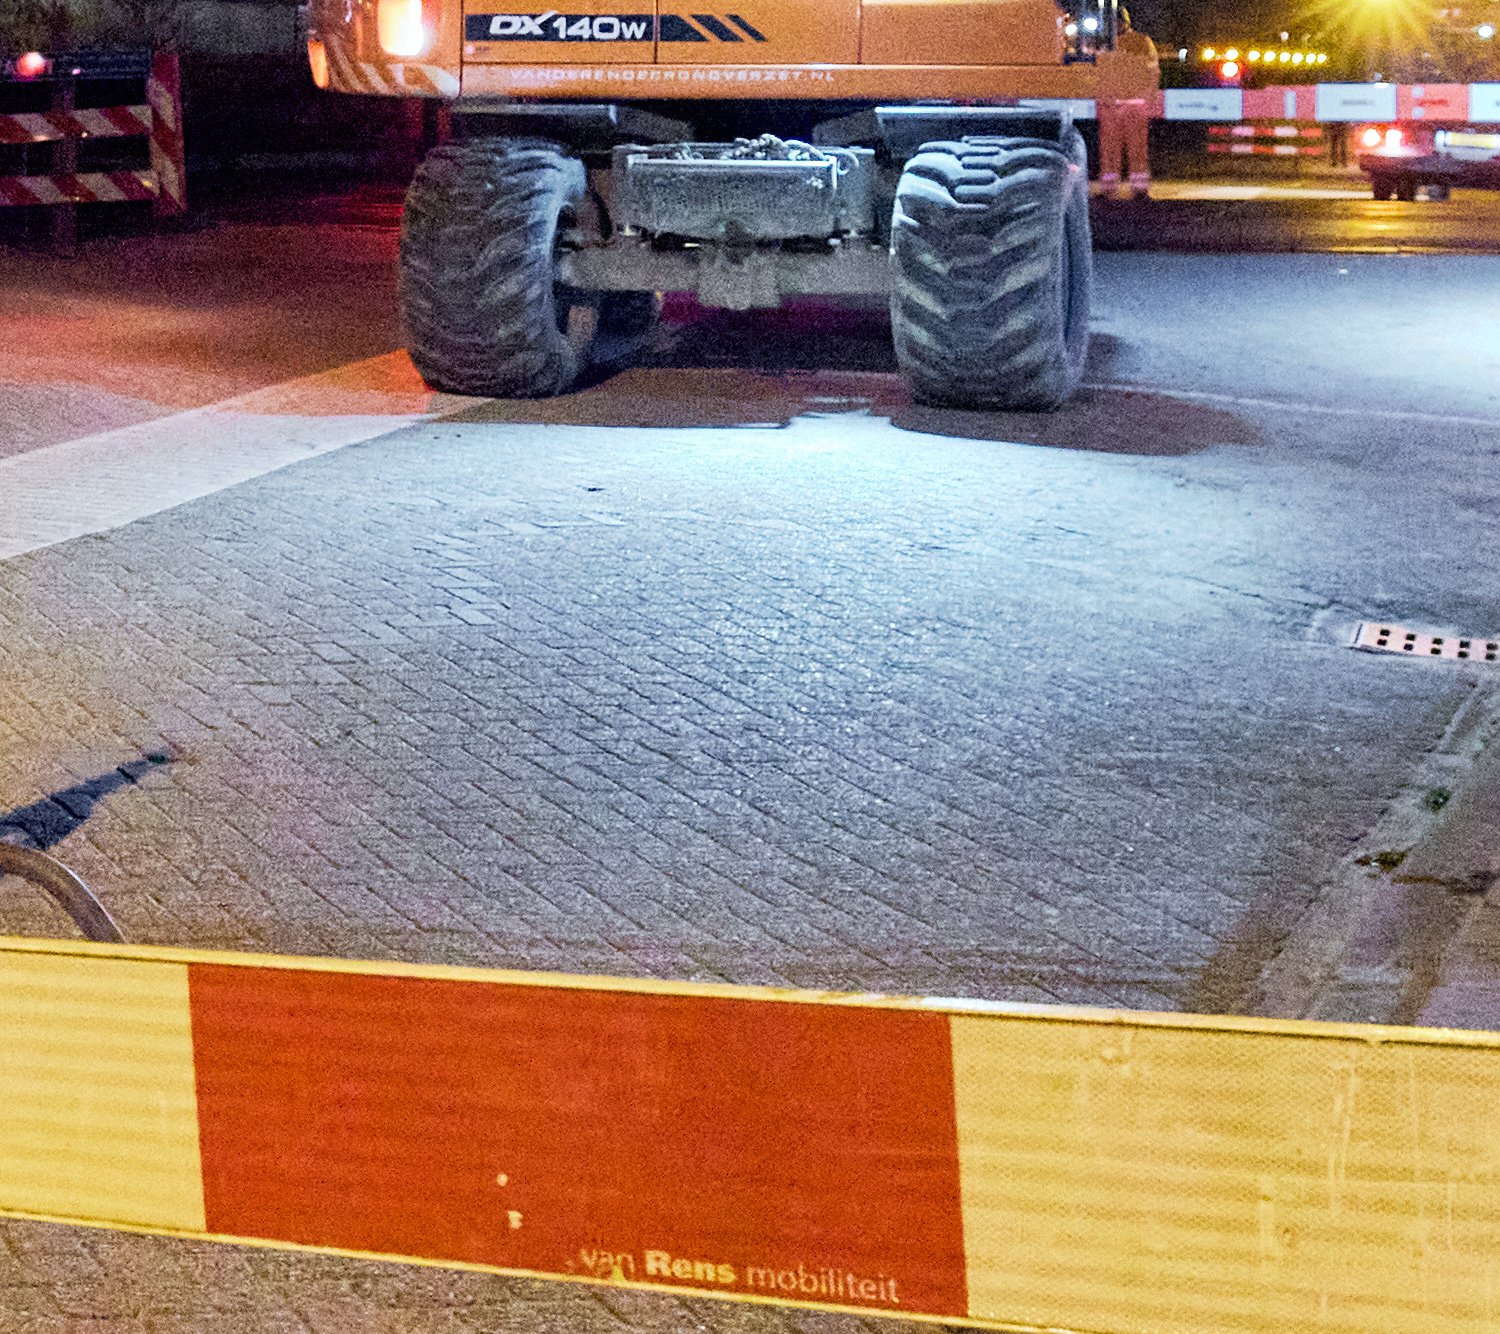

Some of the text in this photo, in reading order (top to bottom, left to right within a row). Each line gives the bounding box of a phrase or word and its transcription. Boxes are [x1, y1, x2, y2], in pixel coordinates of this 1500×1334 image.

[580, 1248, 898, 1302] van Rens mobiliteit
